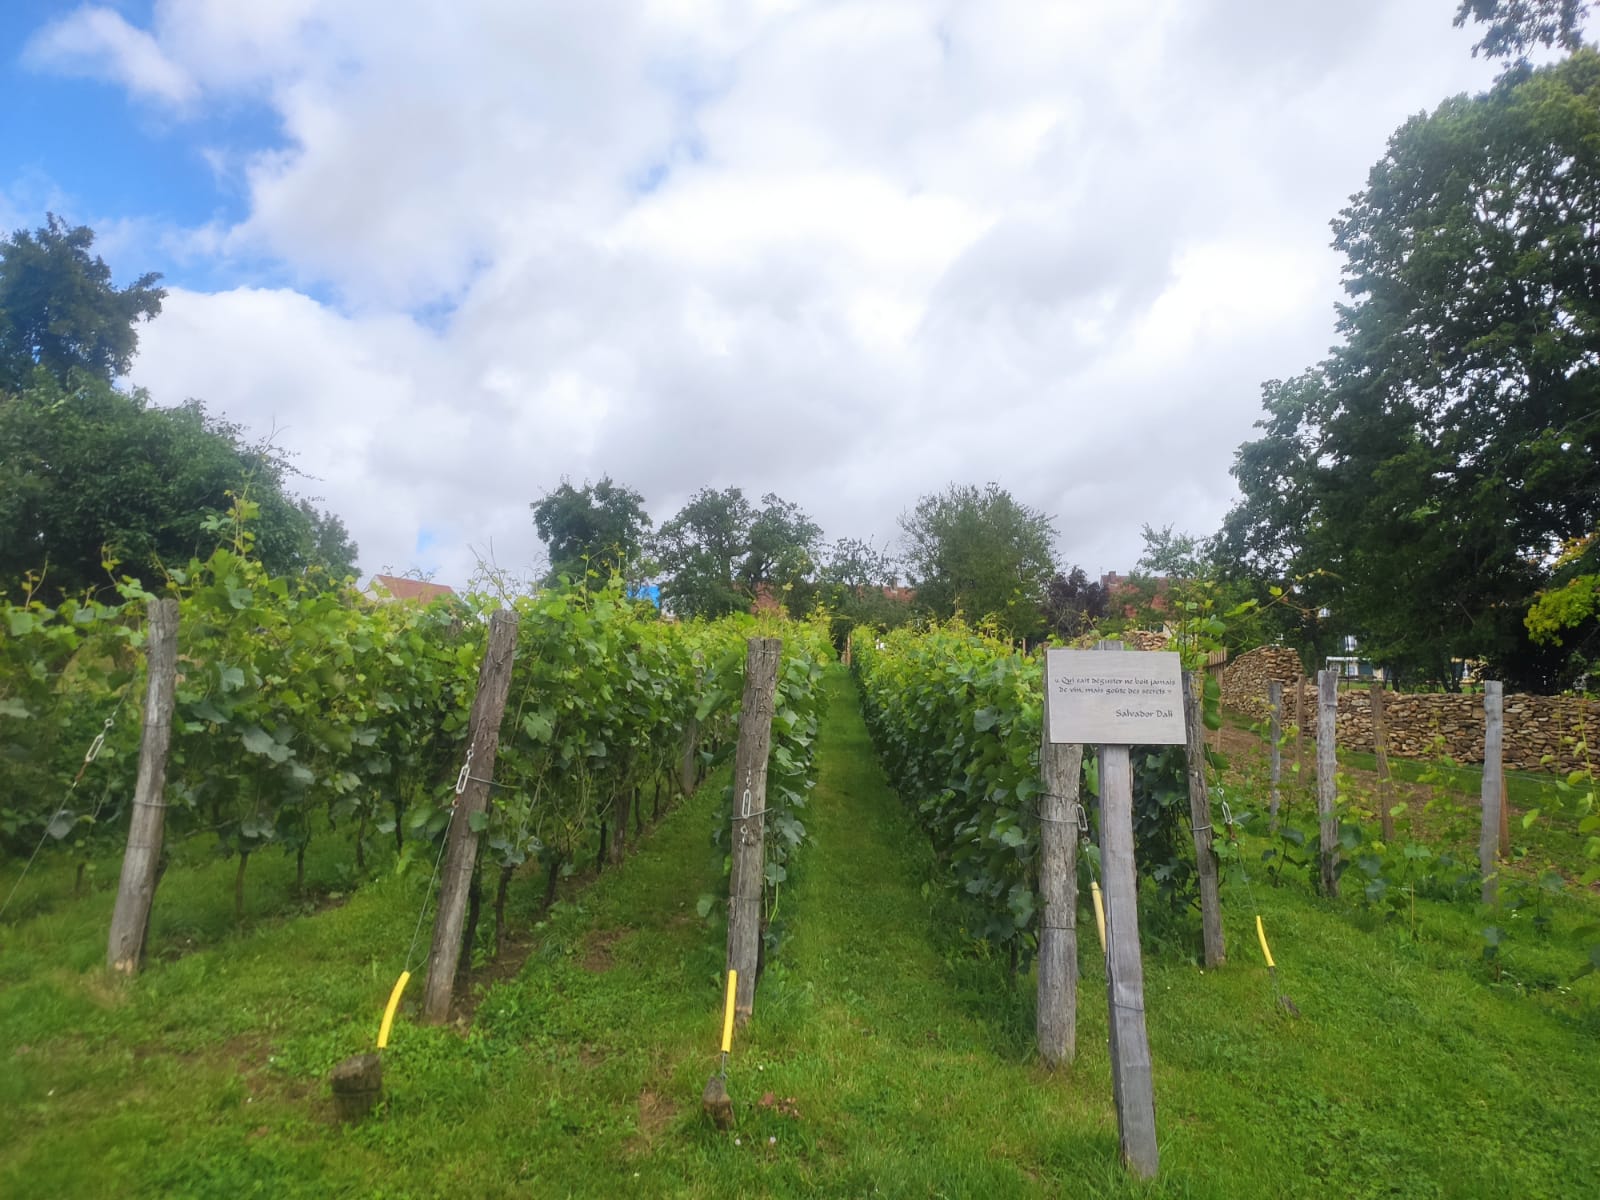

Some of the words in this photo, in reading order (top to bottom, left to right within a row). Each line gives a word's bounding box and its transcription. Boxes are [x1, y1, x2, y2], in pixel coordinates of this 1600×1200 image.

[1150, 678, 1176, 687] jamais
[1127, 687, 1140, 695] des
[1115, 708, 1154, 718] Salvador
